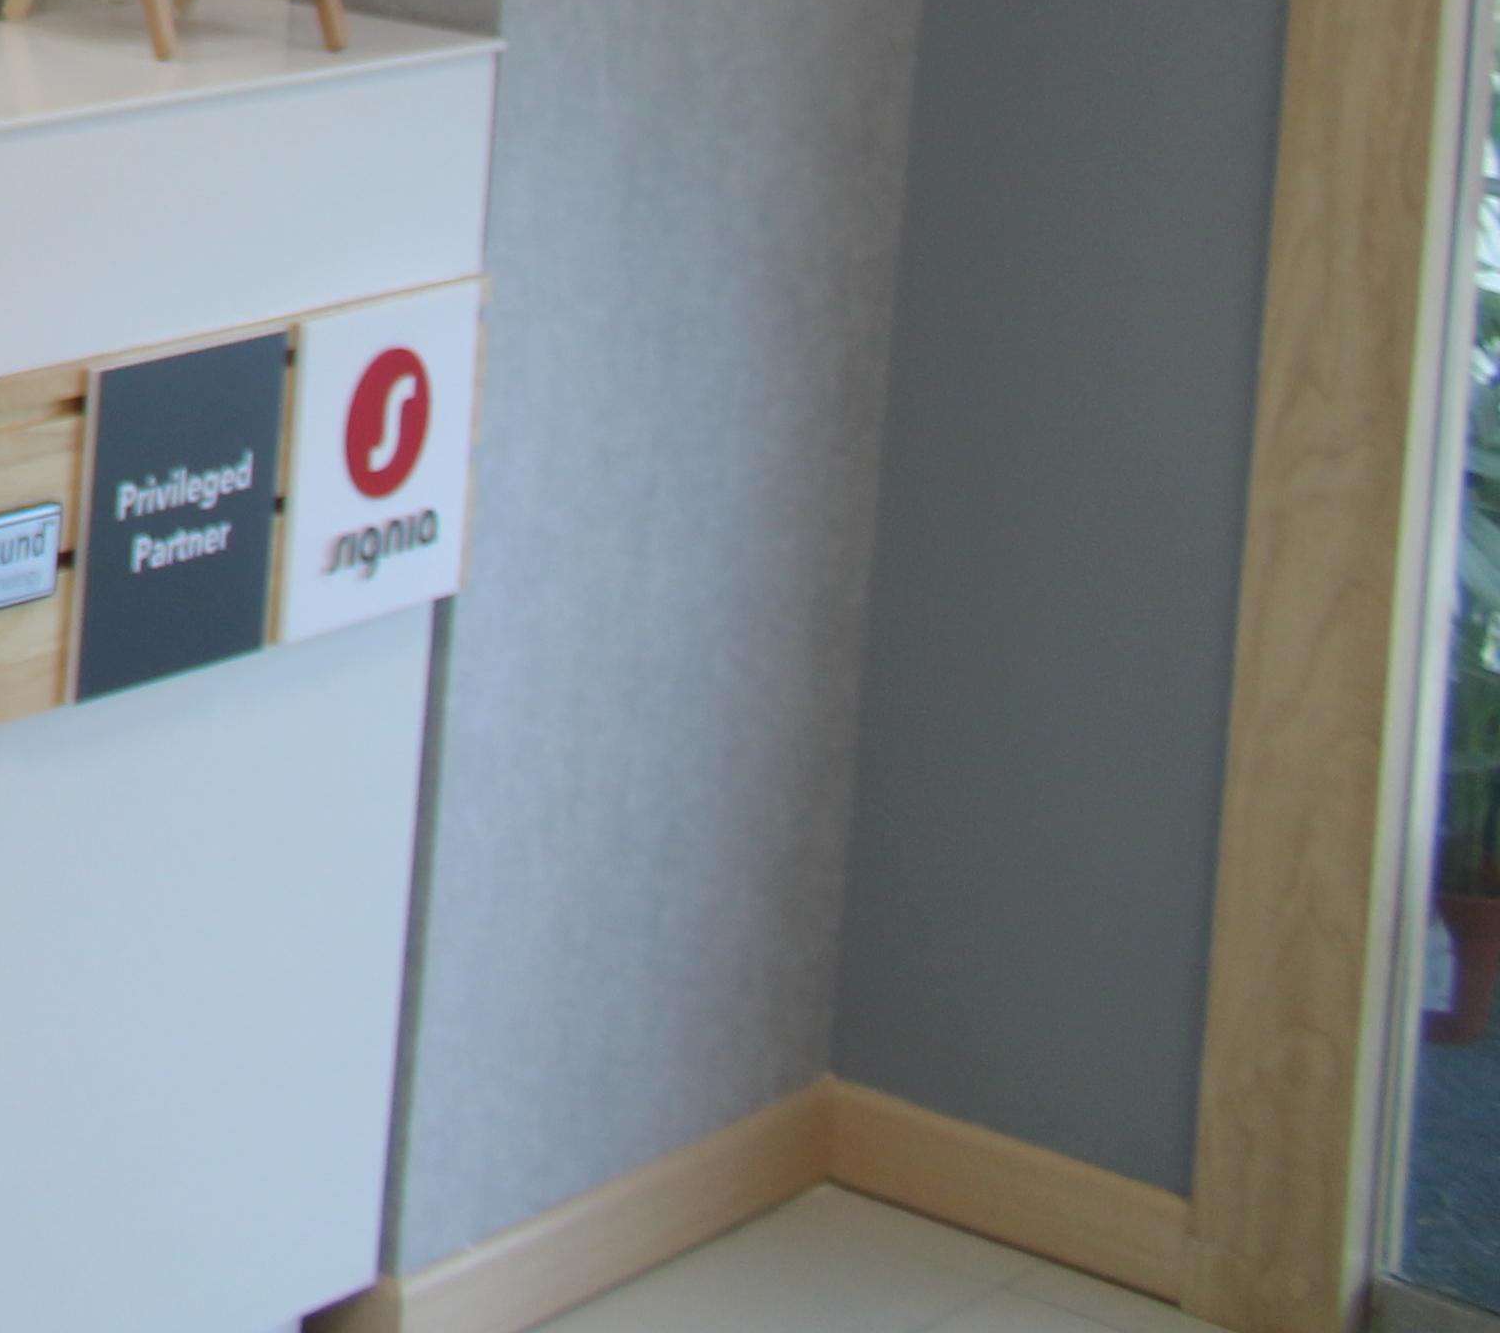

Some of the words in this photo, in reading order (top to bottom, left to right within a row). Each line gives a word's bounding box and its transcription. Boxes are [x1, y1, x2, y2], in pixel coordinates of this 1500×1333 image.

[115, 450, 254, 521] Privileged
[130, 520, 233, 574] Partner
[318, 508, 440, 580] signia
